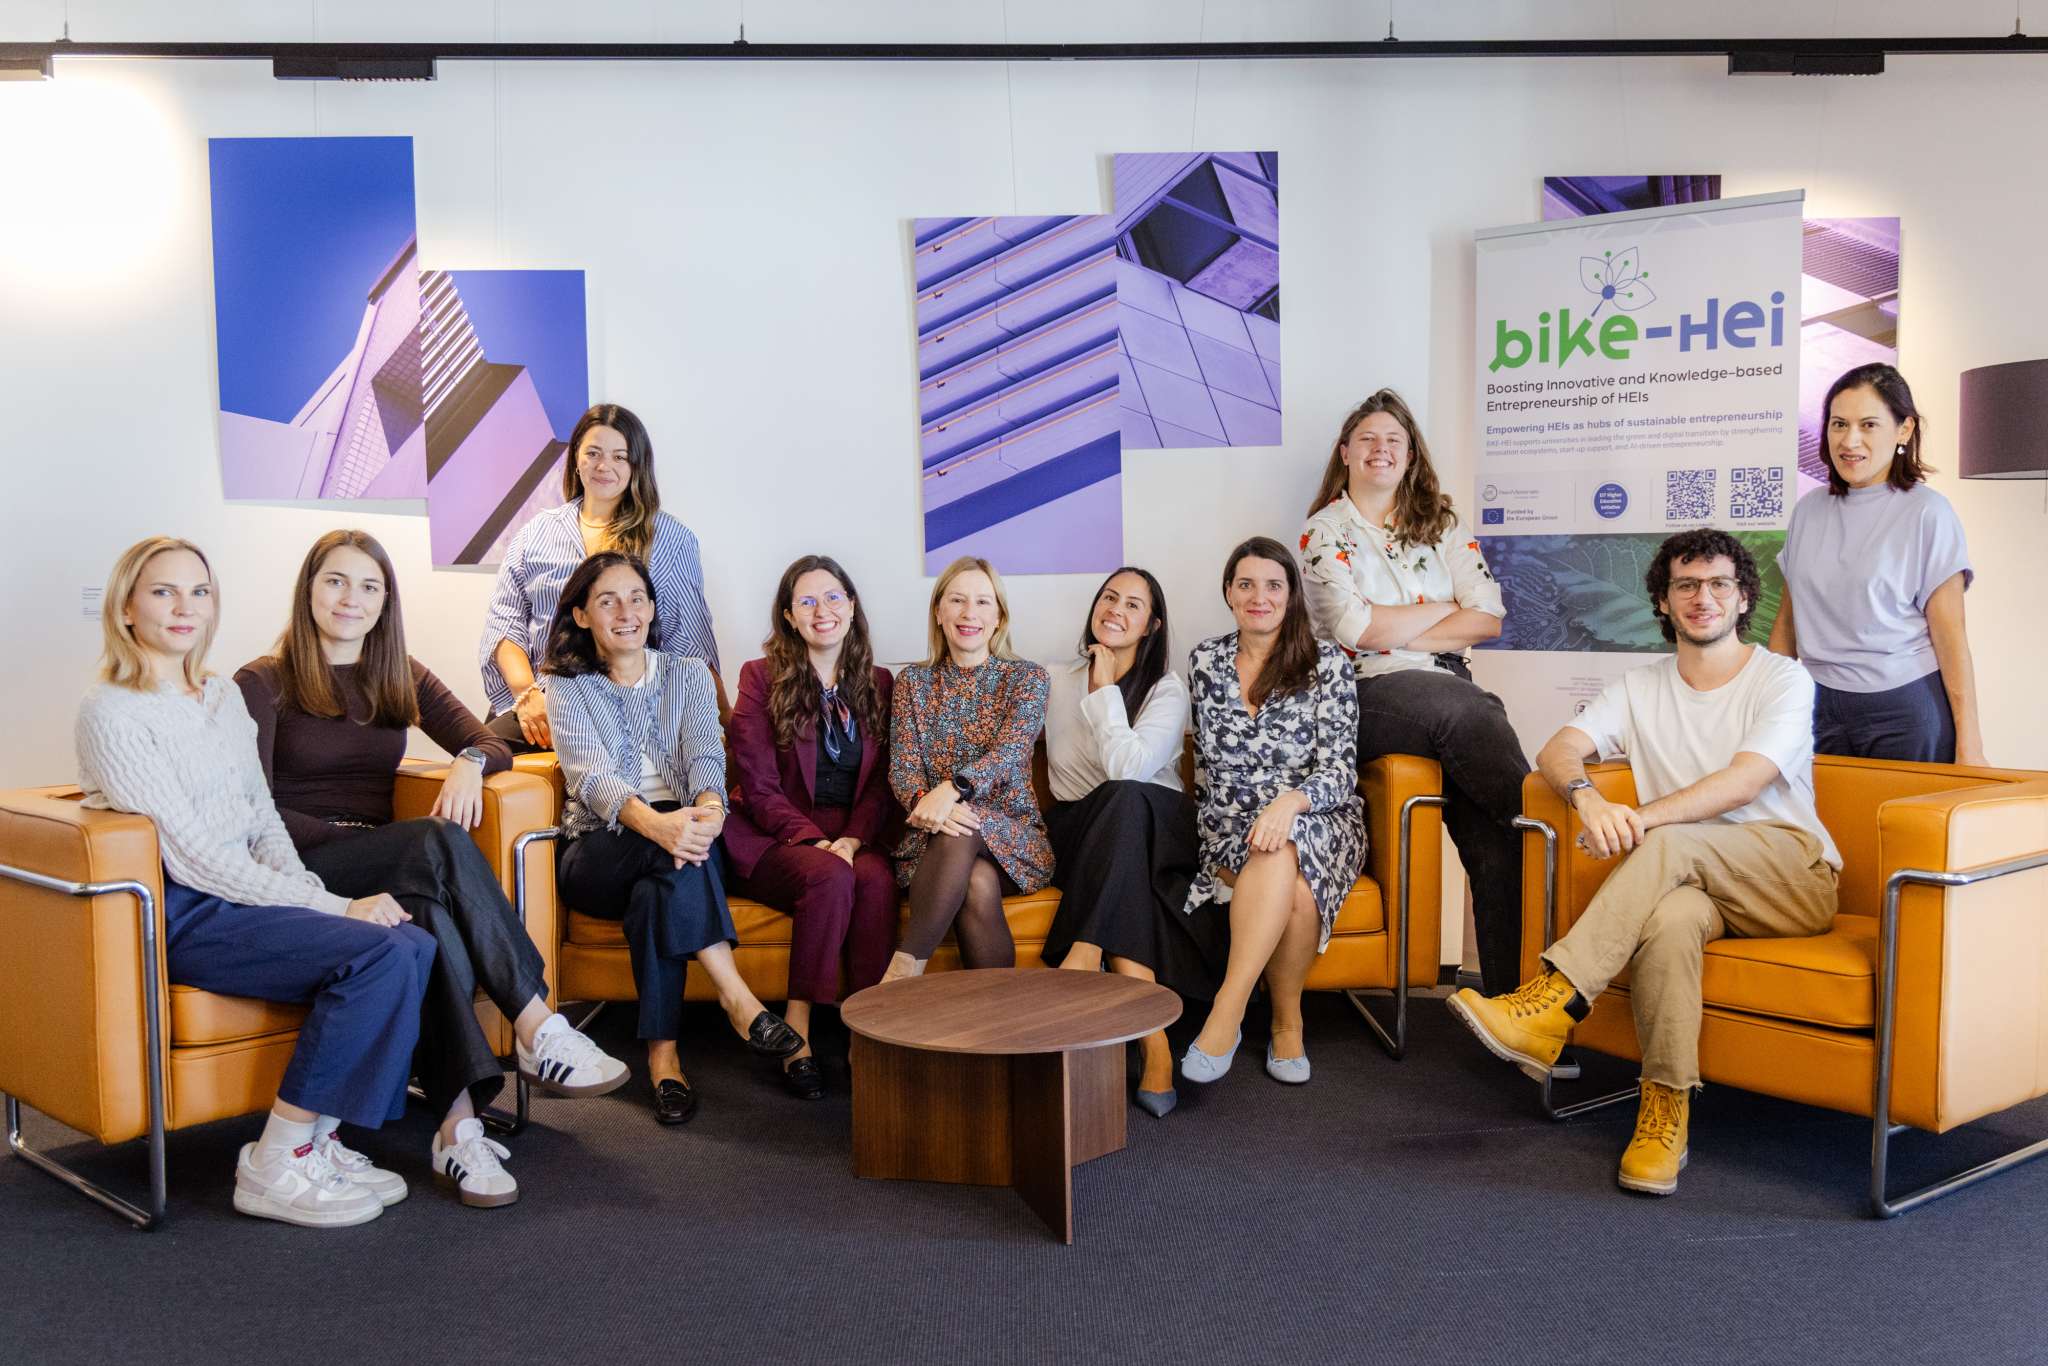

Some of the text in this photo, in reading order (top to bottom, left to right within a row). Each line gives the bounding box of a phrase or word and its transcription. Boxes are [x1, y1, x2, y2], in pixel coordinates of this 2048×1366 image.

[1487, 363, 1783, 395] Boosting Innovative and Knowledge-based
[1487, 391, 1649, 412] Entrepreneurship of HEIs
[1486, 410, 1783, 436] Empowering HEIs as hubs of sustainable entrepreneurship
[1513, 439, 1540, 448] supports
[1648, 432, 1661, 440] and
[1663, 431, 1683, 440] digital
[1685, 429, 1719, 439] transition
[1720, 429, 1729, 438] by
[1731, 426, 1783, 436] strengthening
